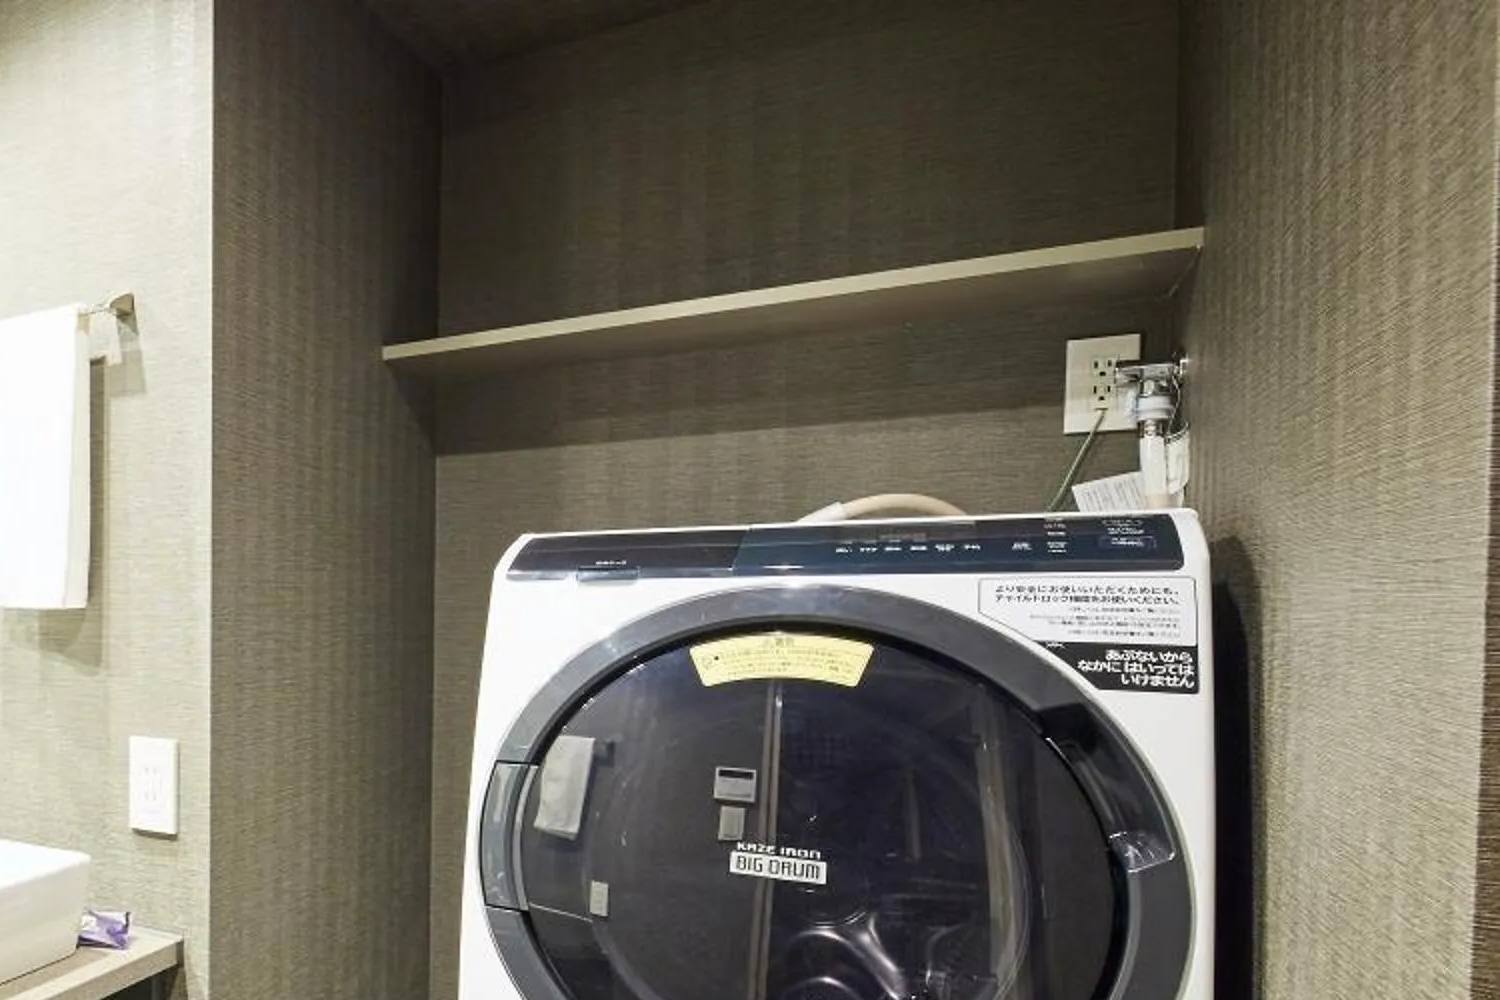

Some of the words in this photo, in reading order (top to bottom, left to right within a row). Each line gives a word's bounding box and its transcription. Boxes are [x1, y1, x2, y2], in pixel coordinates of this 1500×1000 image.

[1105, 650, 1193, 663] あぶないから
[1120, 673, 1195, 688] いけません
[735, 855, 763, 873] BIG
[769, 859, 820, 880] DRUM
